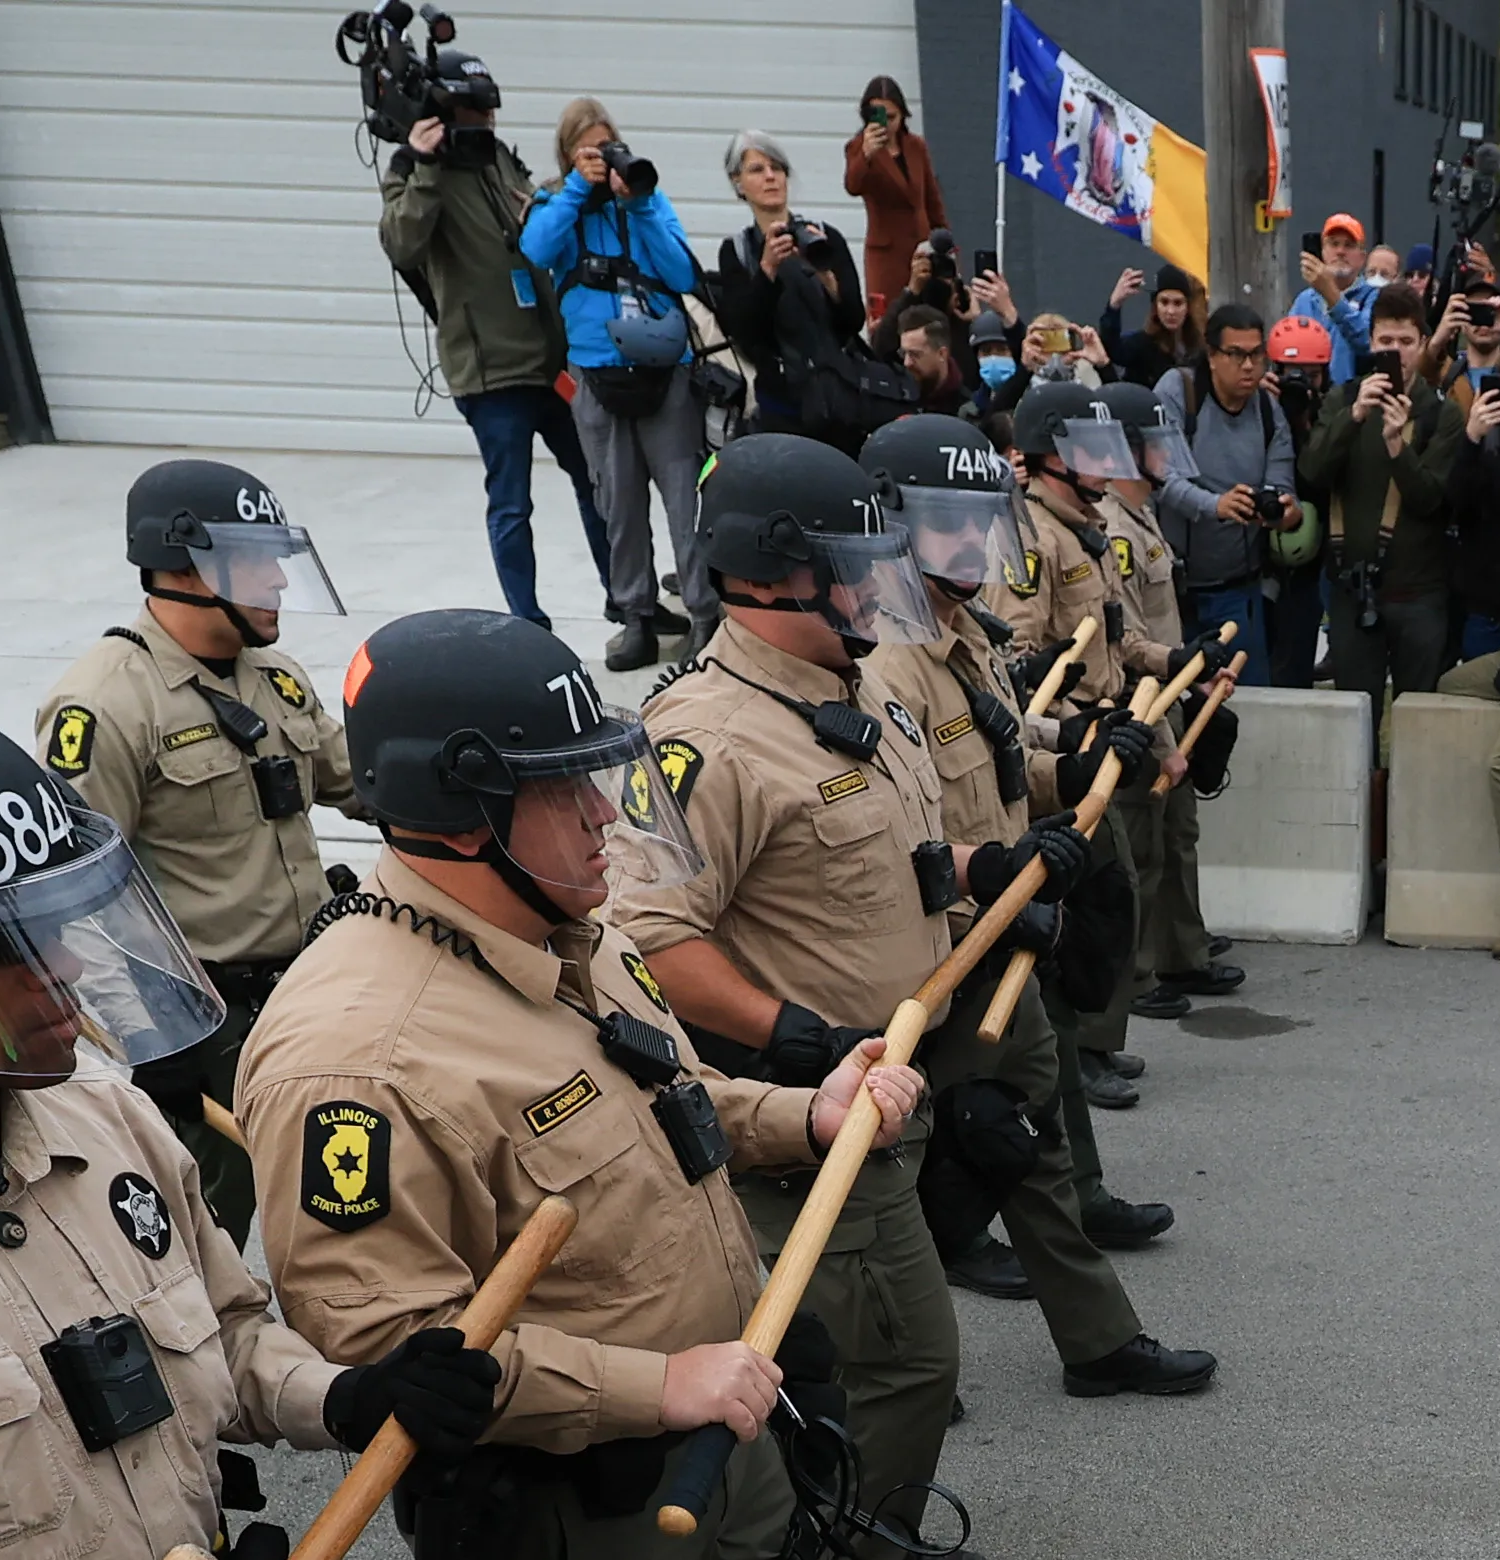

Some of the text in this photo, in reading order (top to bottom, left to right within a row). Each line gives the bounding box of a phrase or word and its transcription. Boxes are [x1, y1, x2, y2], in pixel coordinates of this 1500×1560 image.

[660, 743, 697, 763] ILLINOIS
[317, 1108, 379, 1129] ILLINOIS
[310, 1194, 380, 1216] STATE POLICE
